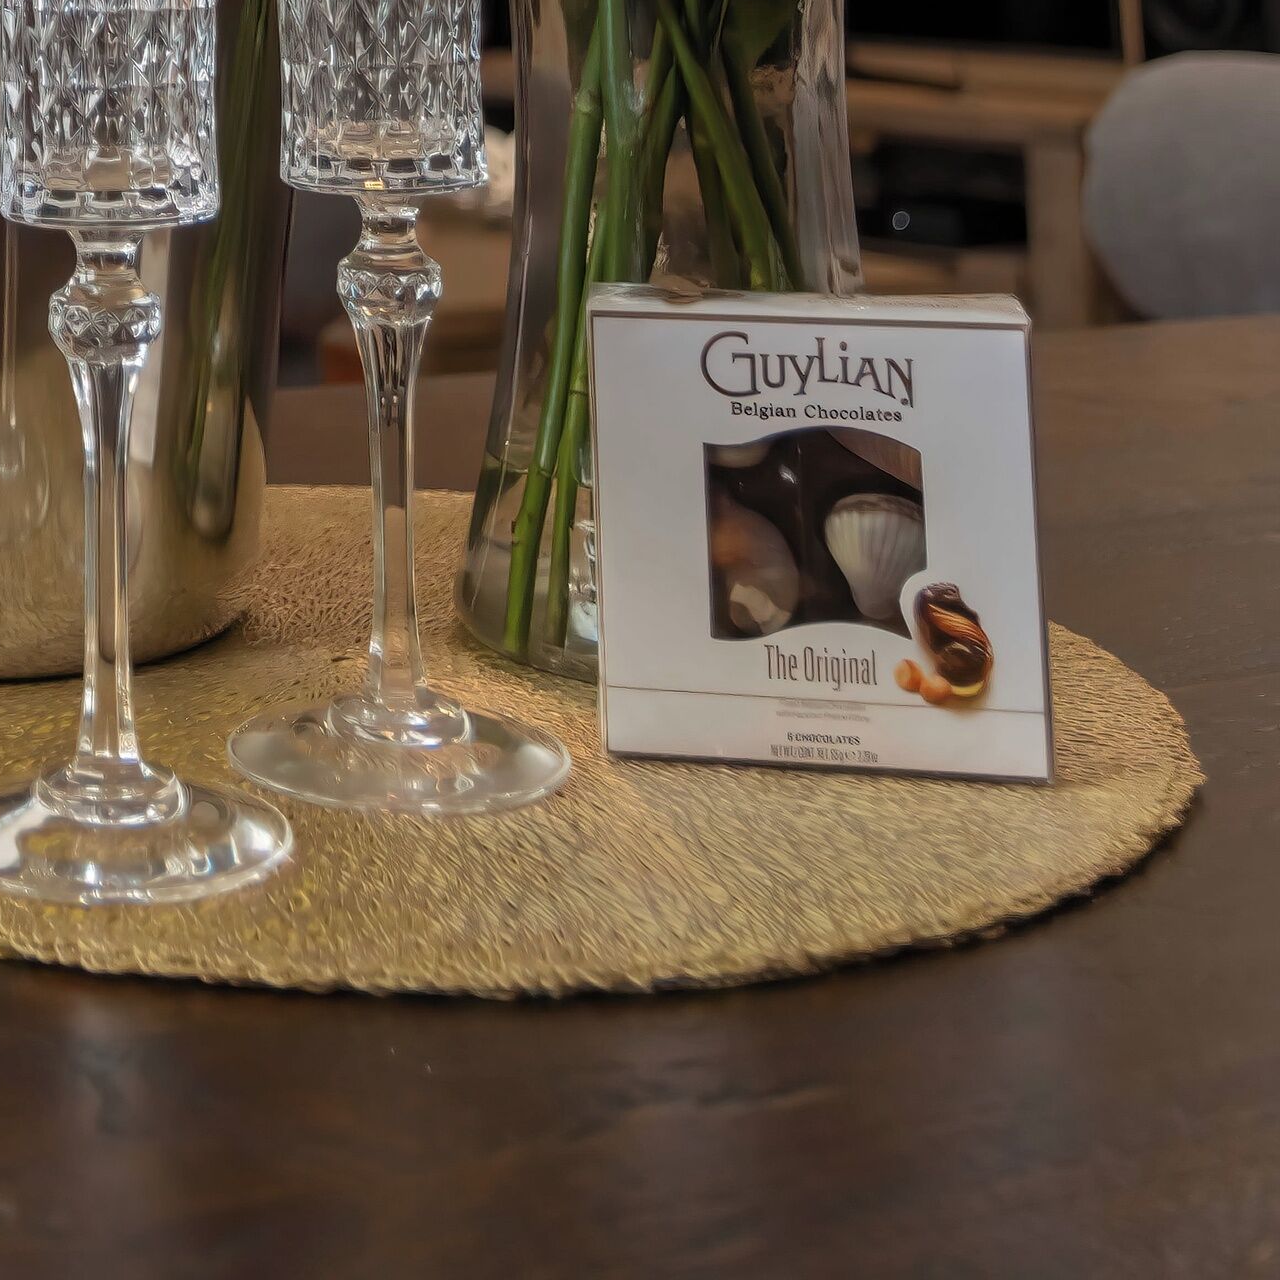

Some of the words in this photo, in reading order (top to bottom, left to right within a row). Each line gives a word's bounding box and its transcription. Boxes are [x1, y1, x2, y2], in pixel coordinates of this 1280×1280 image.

[730, 401, 797, 420] Belgian
[803, 404, 903, 423] Chocolates
[763, 643, 798, 681] The
[803, 645, 878, 692] Original
